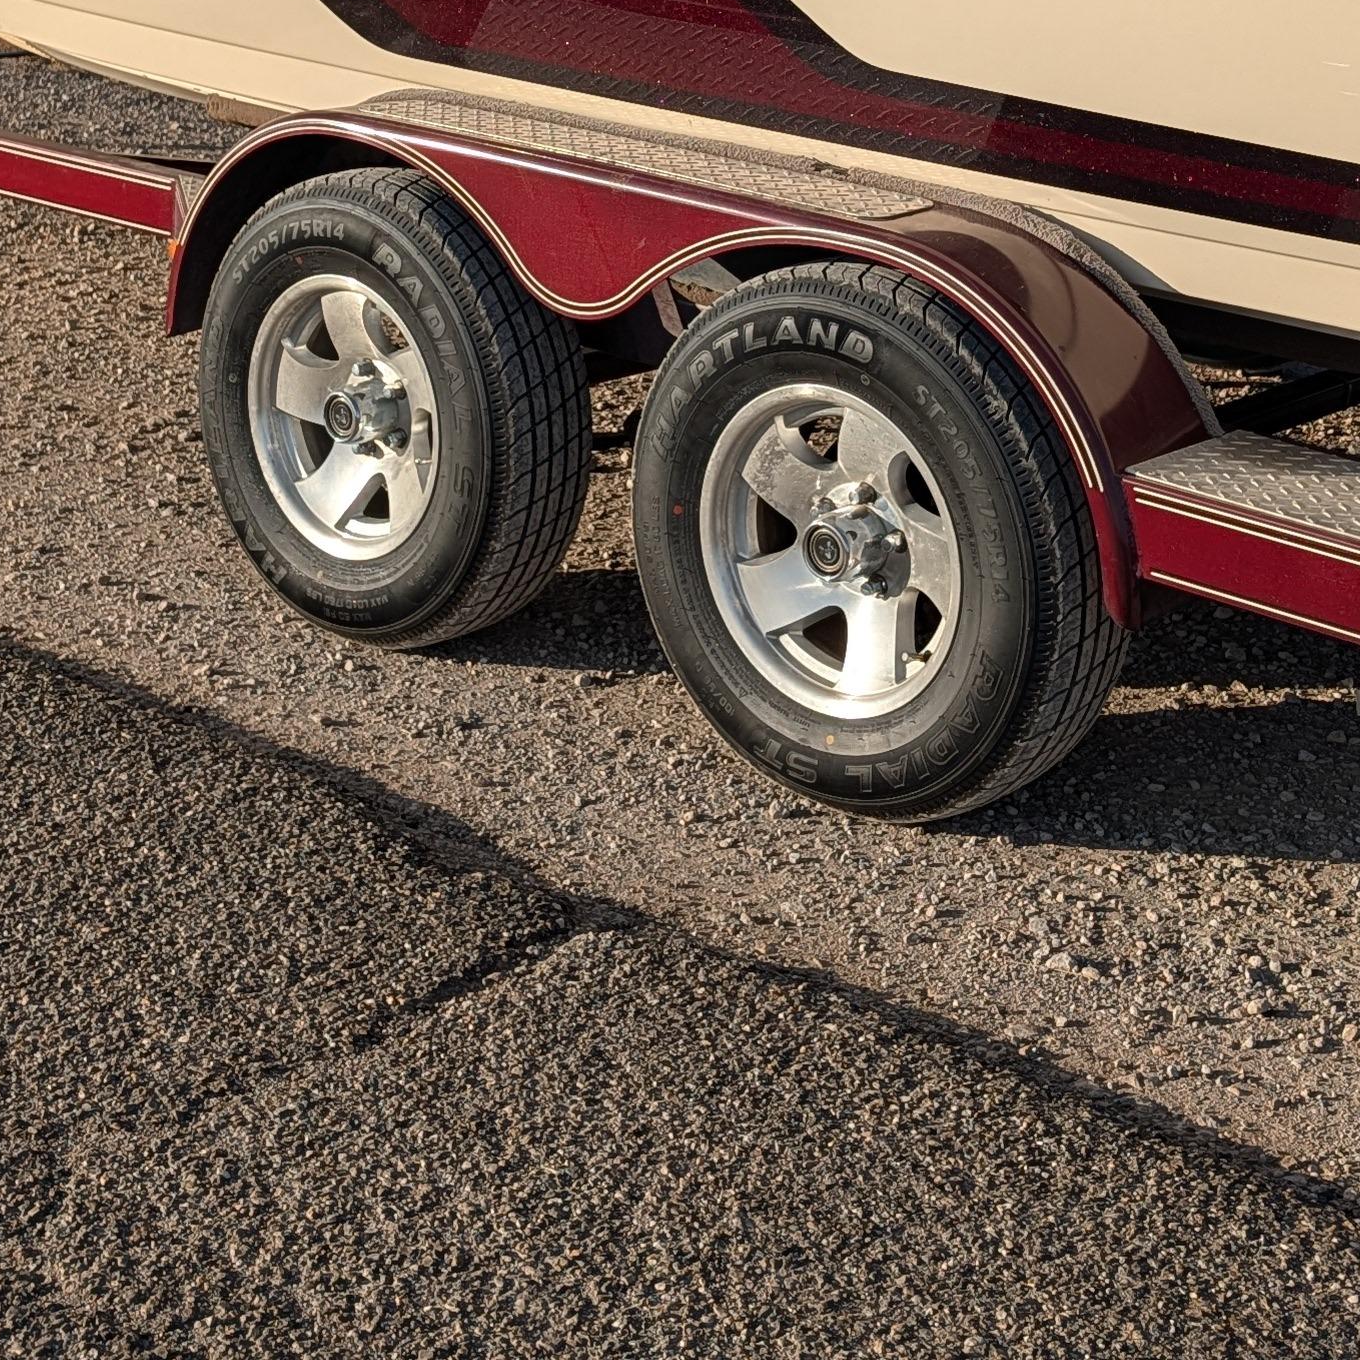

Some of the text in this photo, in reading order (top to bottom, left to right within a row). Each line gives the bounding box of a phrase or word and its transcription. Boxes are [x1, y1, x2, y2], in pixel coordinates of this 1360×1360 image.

[371, 242, 473, 436] RADIAL
[652, 315, 875, 461] HARTLAND
[845, 650, 1007, 793] RADIAL
